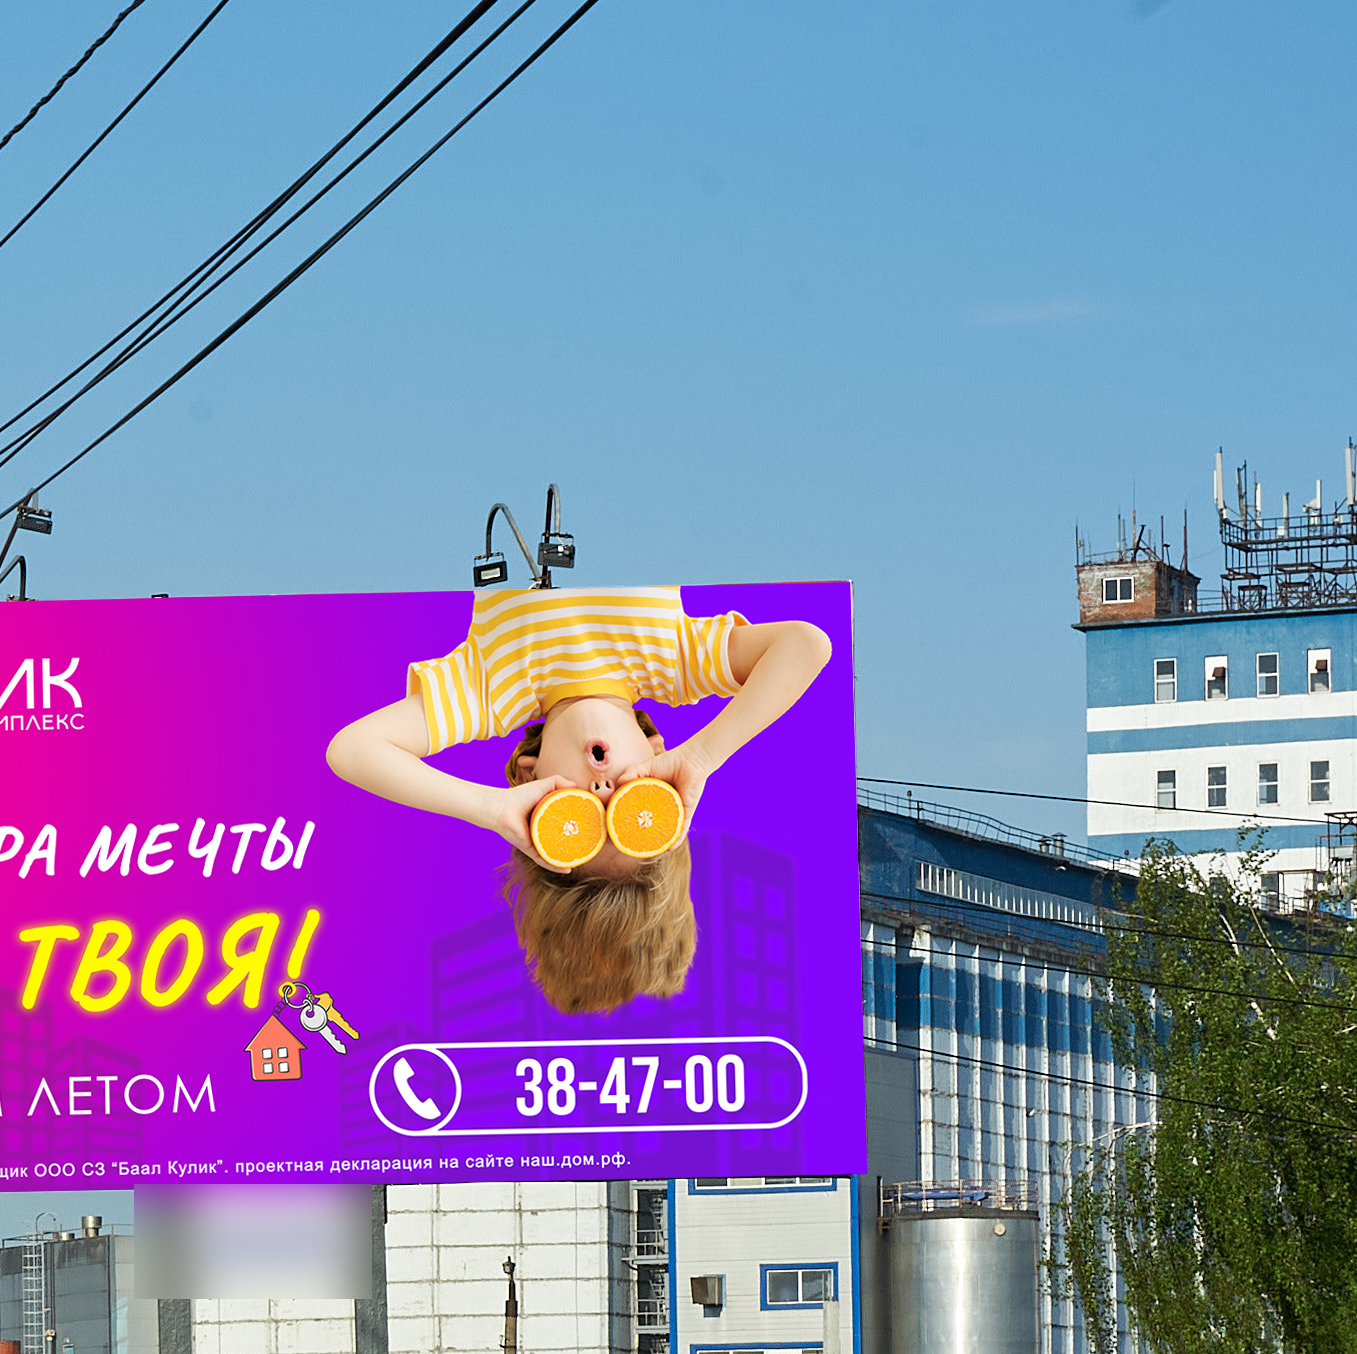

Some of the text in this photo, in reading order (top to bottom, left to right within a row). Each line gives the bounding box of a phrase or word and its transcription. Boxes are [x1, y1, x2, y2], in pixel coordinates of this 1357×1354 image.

[79, 816, 316, 878] МЕЧТЫ
[18, 908, 321, 1014] ТВОЯ!
[26, 1073, 217, 1116] ЛЕТОМ
[514, 1053, 746, 1117] 38-47-00
[34, 1162, 76, 1178] ООО
[81, 1161, 106, 1177] СЗ
[235, 1160, 324, 1176] проектная
[329, 1158, 433, 1174] декларация
[439, 1157, 459, 1169] на
[465, 1153, 514, 1169] сайте
[520, 1151, 631, 1169] наш.дом.рф.
